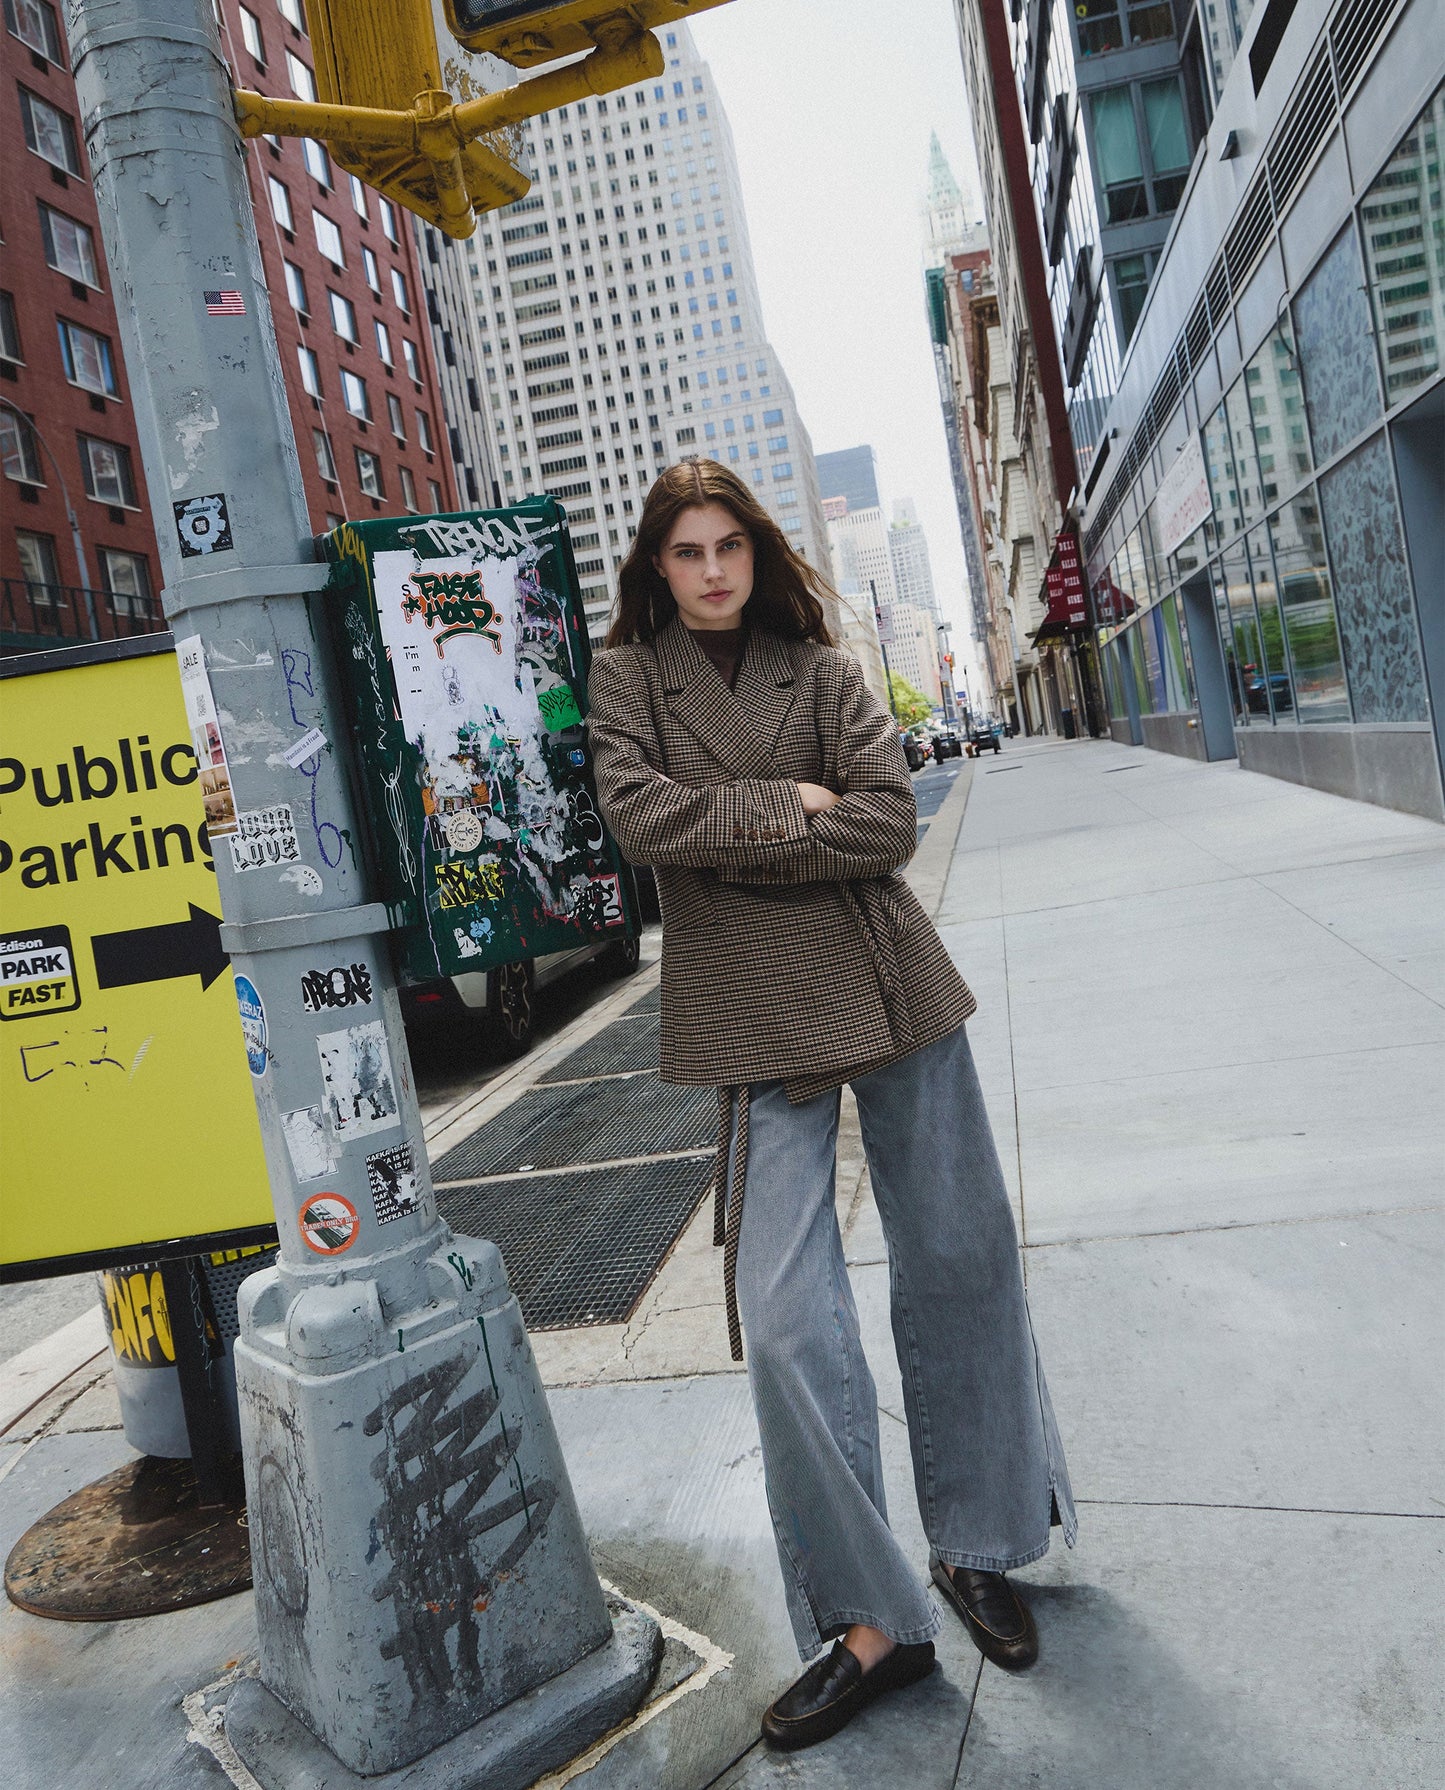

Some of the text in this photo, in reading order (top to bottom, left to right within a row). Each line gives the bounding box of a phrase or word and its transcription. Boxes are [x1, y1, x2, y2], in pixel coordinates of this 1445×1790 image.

[1059, 541, 1075, 551] DELI
[0, 735, 200, 814] Public
[0, 938, 44, 954] Edison
[1, 953, 65, 980] PARK
[8, 981, 67, 1008] FAST
[366, 1149, 391, 1163] KAFKA
[326, 1218, 343, 1227] ONLY
[378, 1211, 402, 1226] KAFKA
